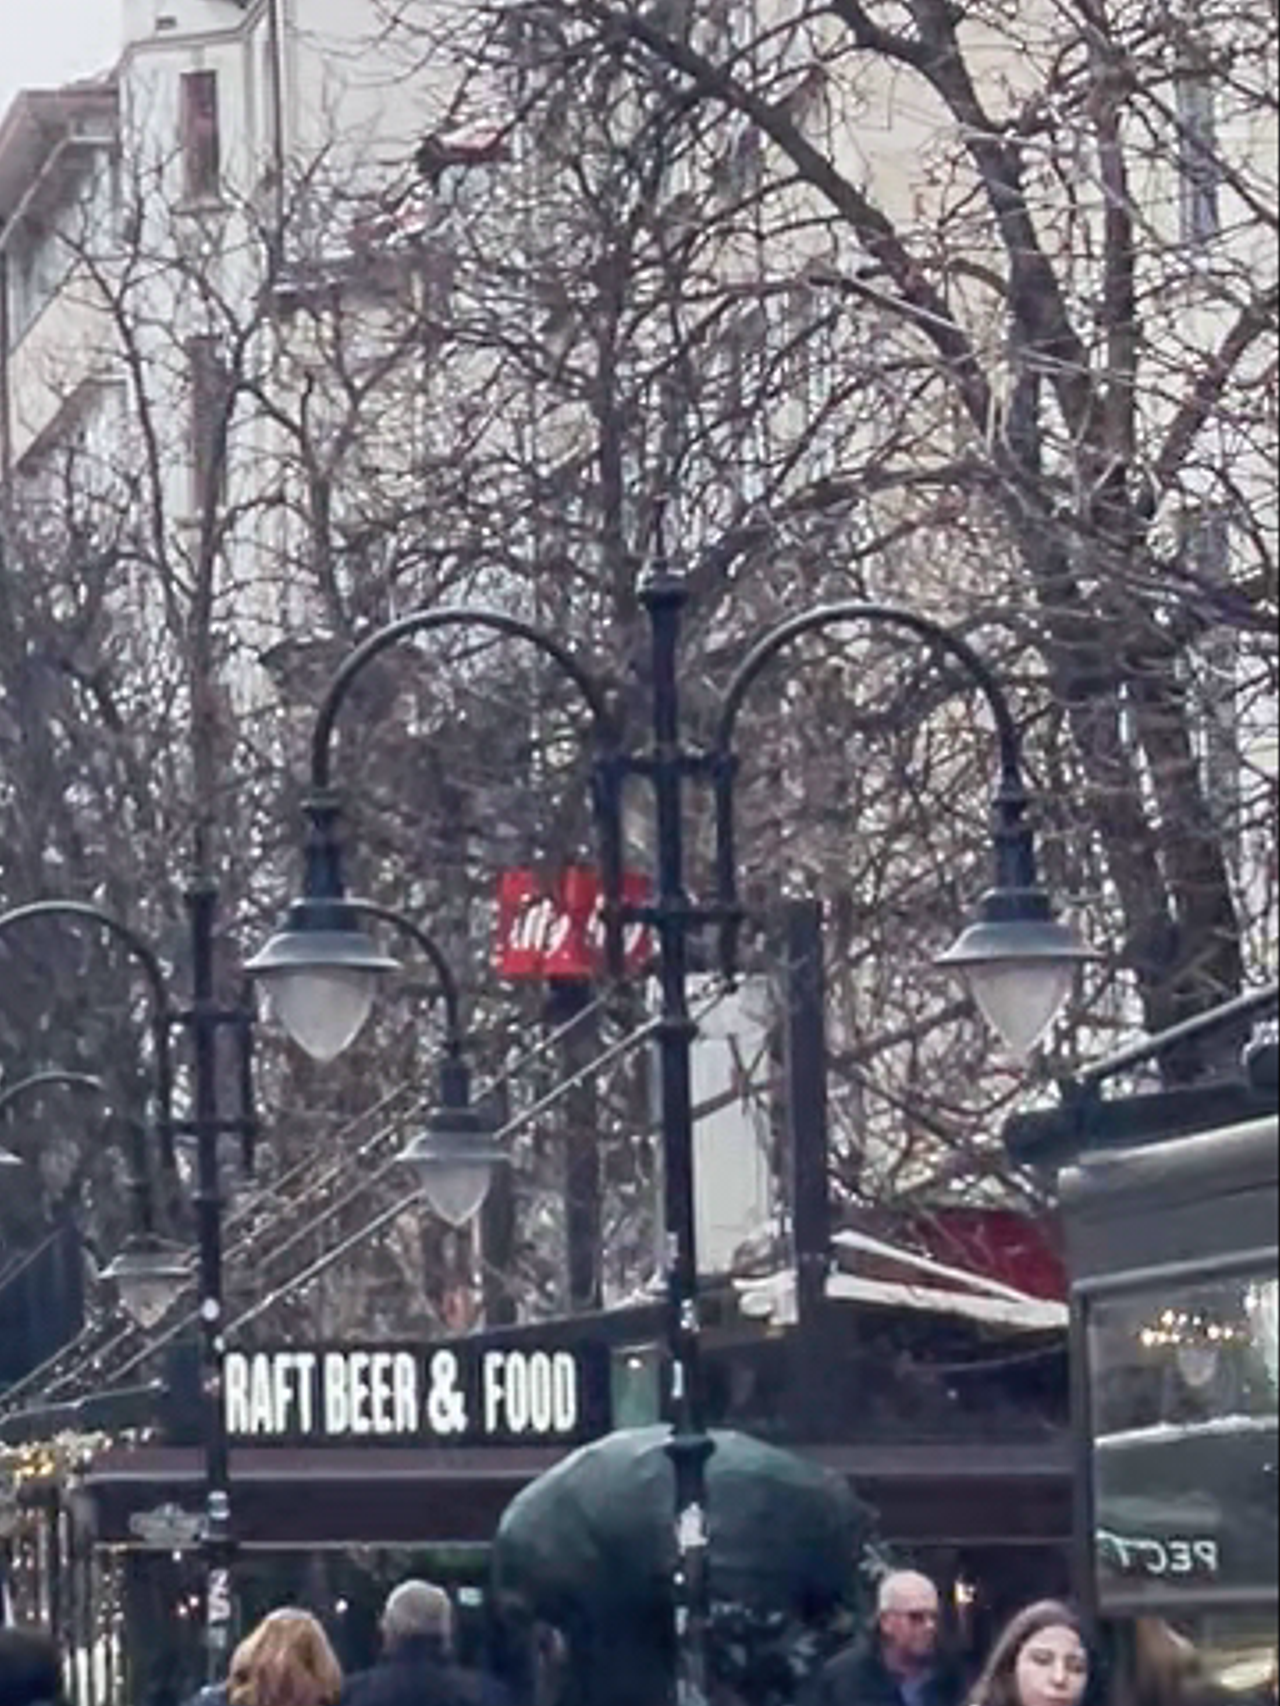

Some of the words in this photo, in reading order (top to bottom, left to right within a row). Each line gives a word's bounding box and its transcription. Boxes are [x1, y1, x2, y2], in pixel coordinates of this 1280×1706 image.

[224, 1351, 315, 1434] RAFT
[324, 1351, 418, 1434] BEER
[427, 1349, 468, 1435] &
[483, 1351, 577, 1434] FOOD
